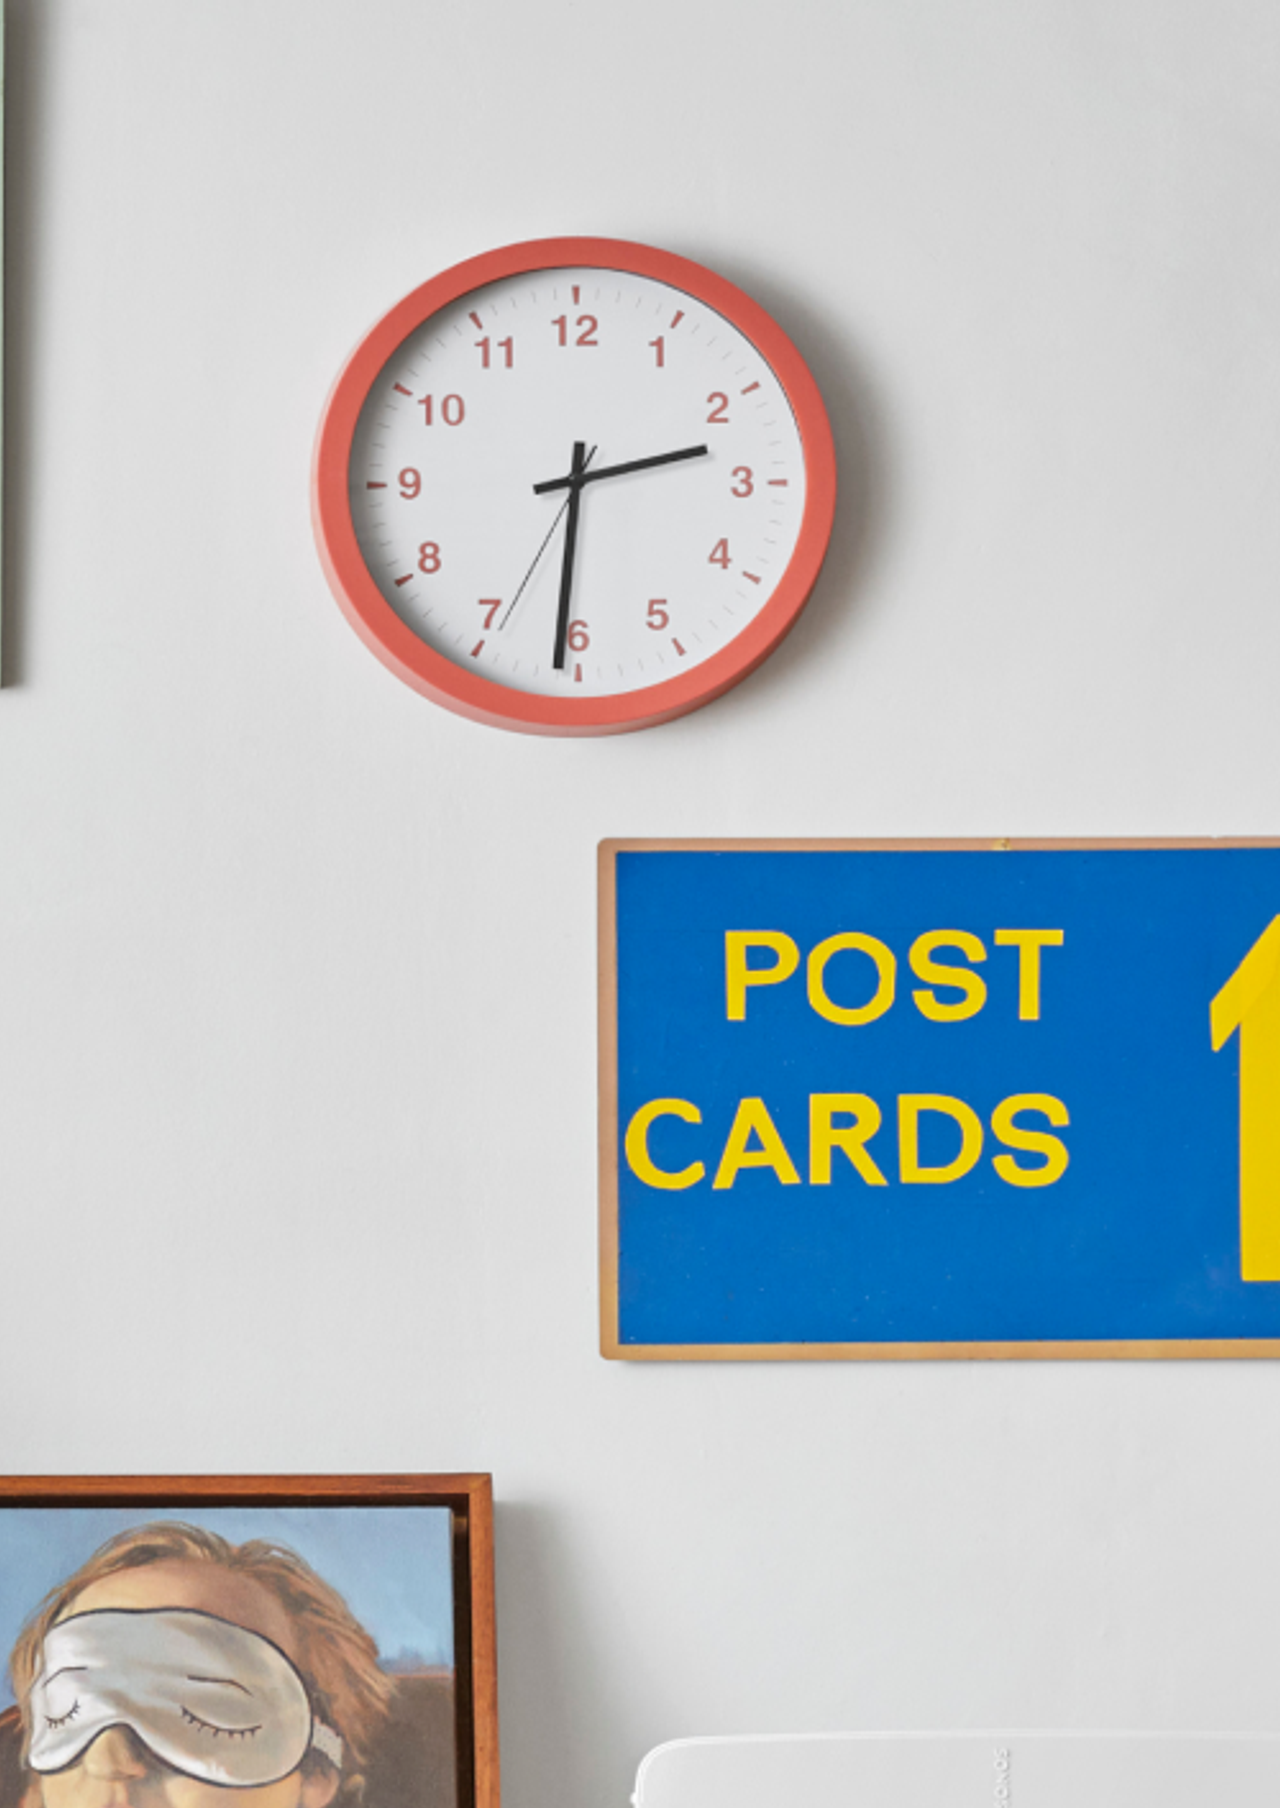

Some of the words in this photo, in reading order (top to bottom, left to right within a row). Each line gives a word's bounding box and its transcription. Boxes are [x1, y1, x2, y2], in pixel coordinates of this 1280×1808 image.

[551, 315, 599, 347] 12
[474, 336, 514, 369] 11
[648, 336, 666, 368] 1
[416, 393, 466, 427] 10
[705, 391, 730, 424] 2
[397, 467, 422, 500] 9
[730, 465, 755, 499] 3
[416, 541, 442, 575] 8
[707, 537, 732, 570] 4
[477, 598, 503, 631] 7
[645, 598, 670, 631] 5
[566, 619, 591, 653] 6
[725, 928, 1064, 1026] POST
[624, 1093, 1070, 1190] CARDS
